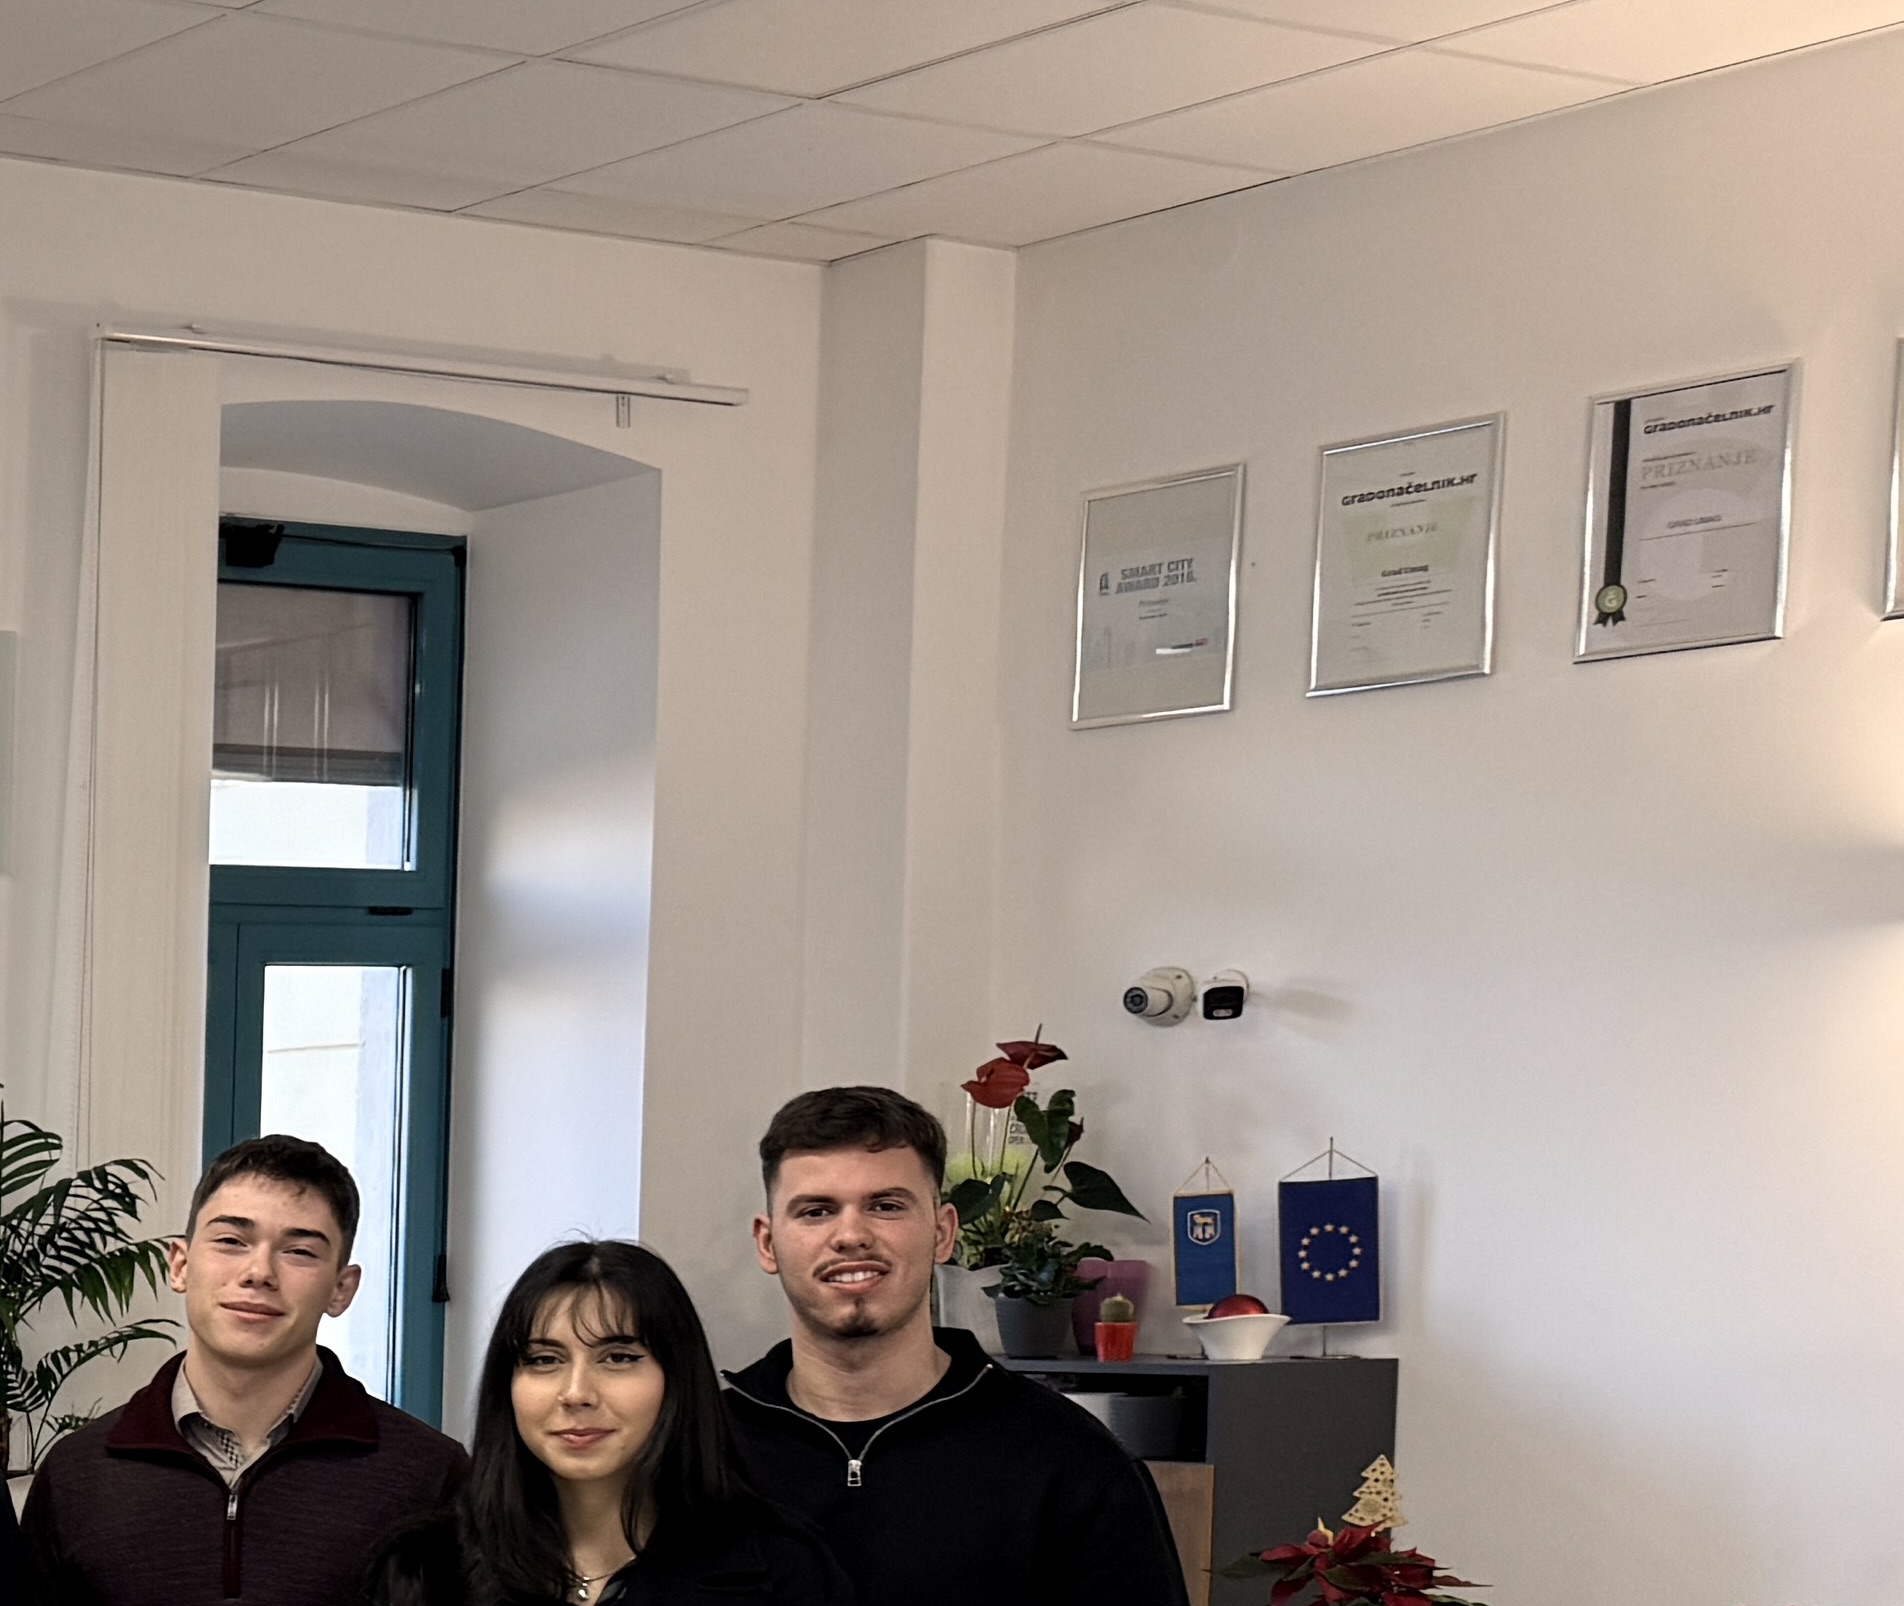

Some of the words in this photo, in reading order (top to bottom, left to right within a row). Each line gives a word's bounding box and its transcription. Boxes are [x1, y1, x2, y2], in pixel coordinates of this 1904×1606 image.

[1641, 452, 1758, 480] PRIZNANJE
[1121, 562, 1163, 579] SMART
[1167, 558, 1194, 574] CITY
